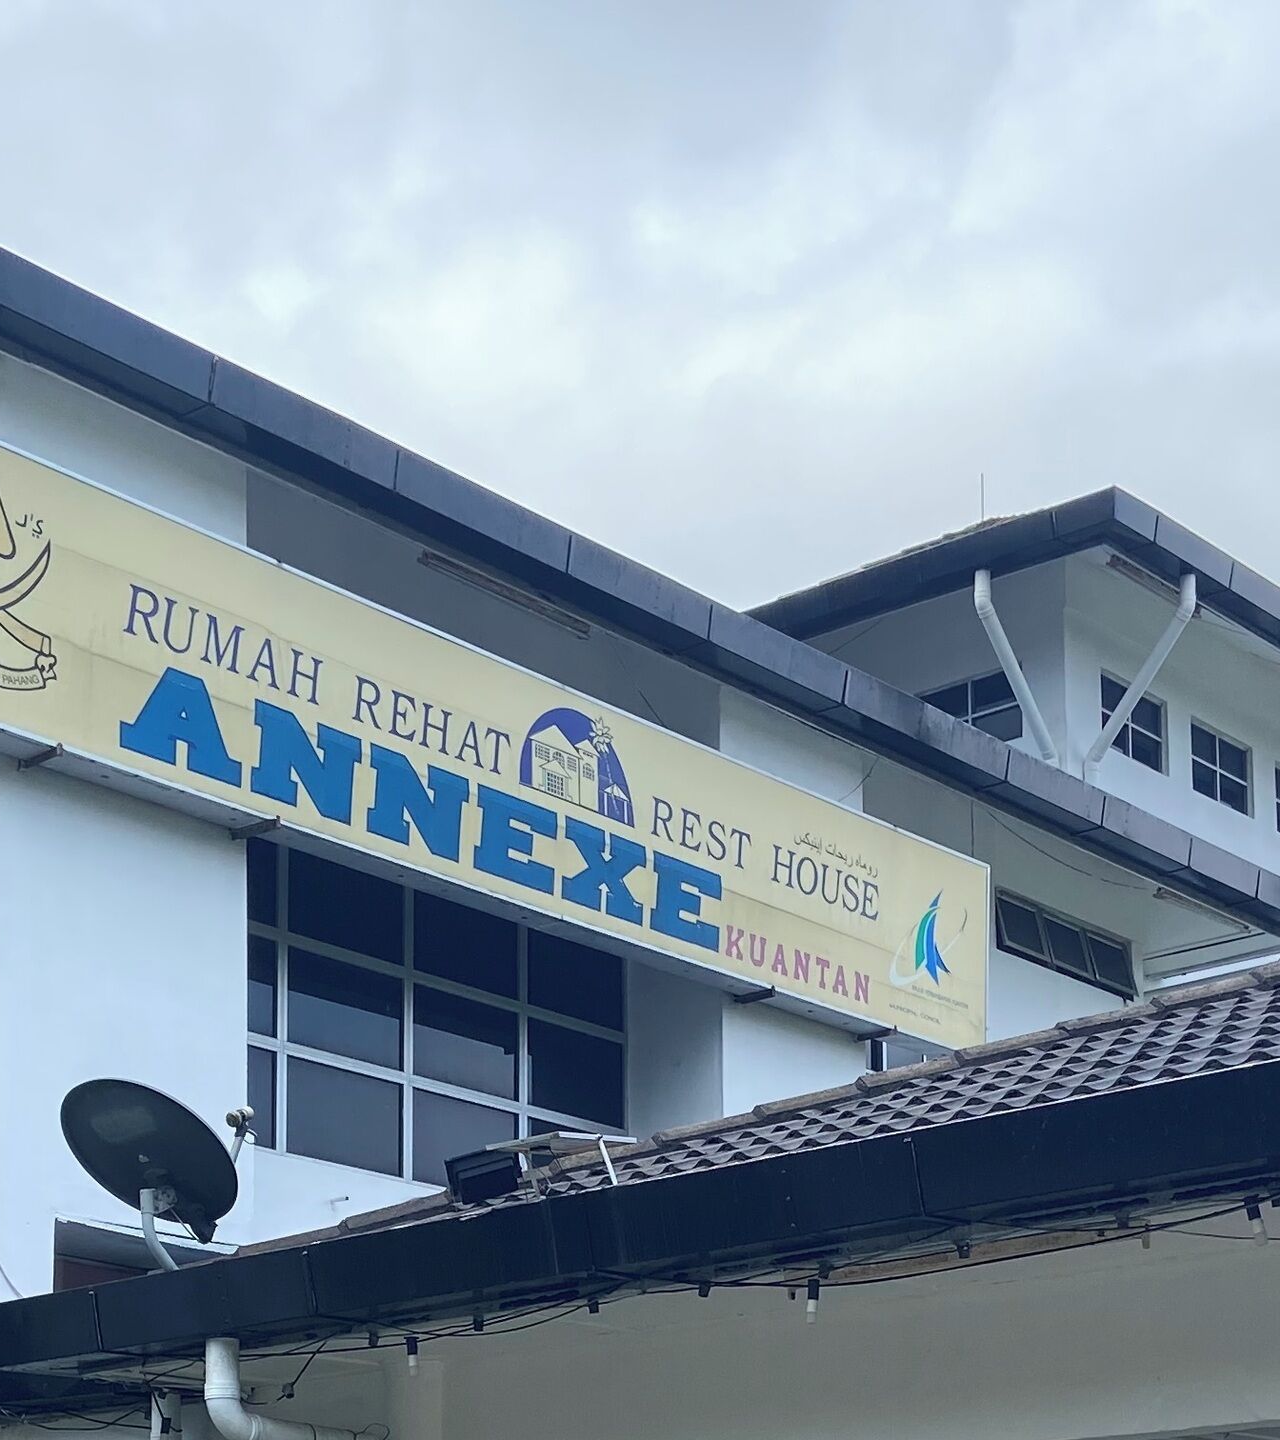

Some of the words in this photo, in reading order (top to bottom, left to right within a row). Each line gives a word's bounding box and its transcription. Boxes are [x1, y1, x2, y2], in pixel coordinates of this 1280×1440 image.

[1, 673, 40, 685] PAHANG
[123, 583, 323, 705] RUMAH
[352, 674, 512, 775] REHAT
[120, 666, 723, 954] ANNEXE
[651, 796, 752, 870] REST
[770, 843, 880, 922] HOUSE
[725, 924, 871, 1005] KUANTAN
